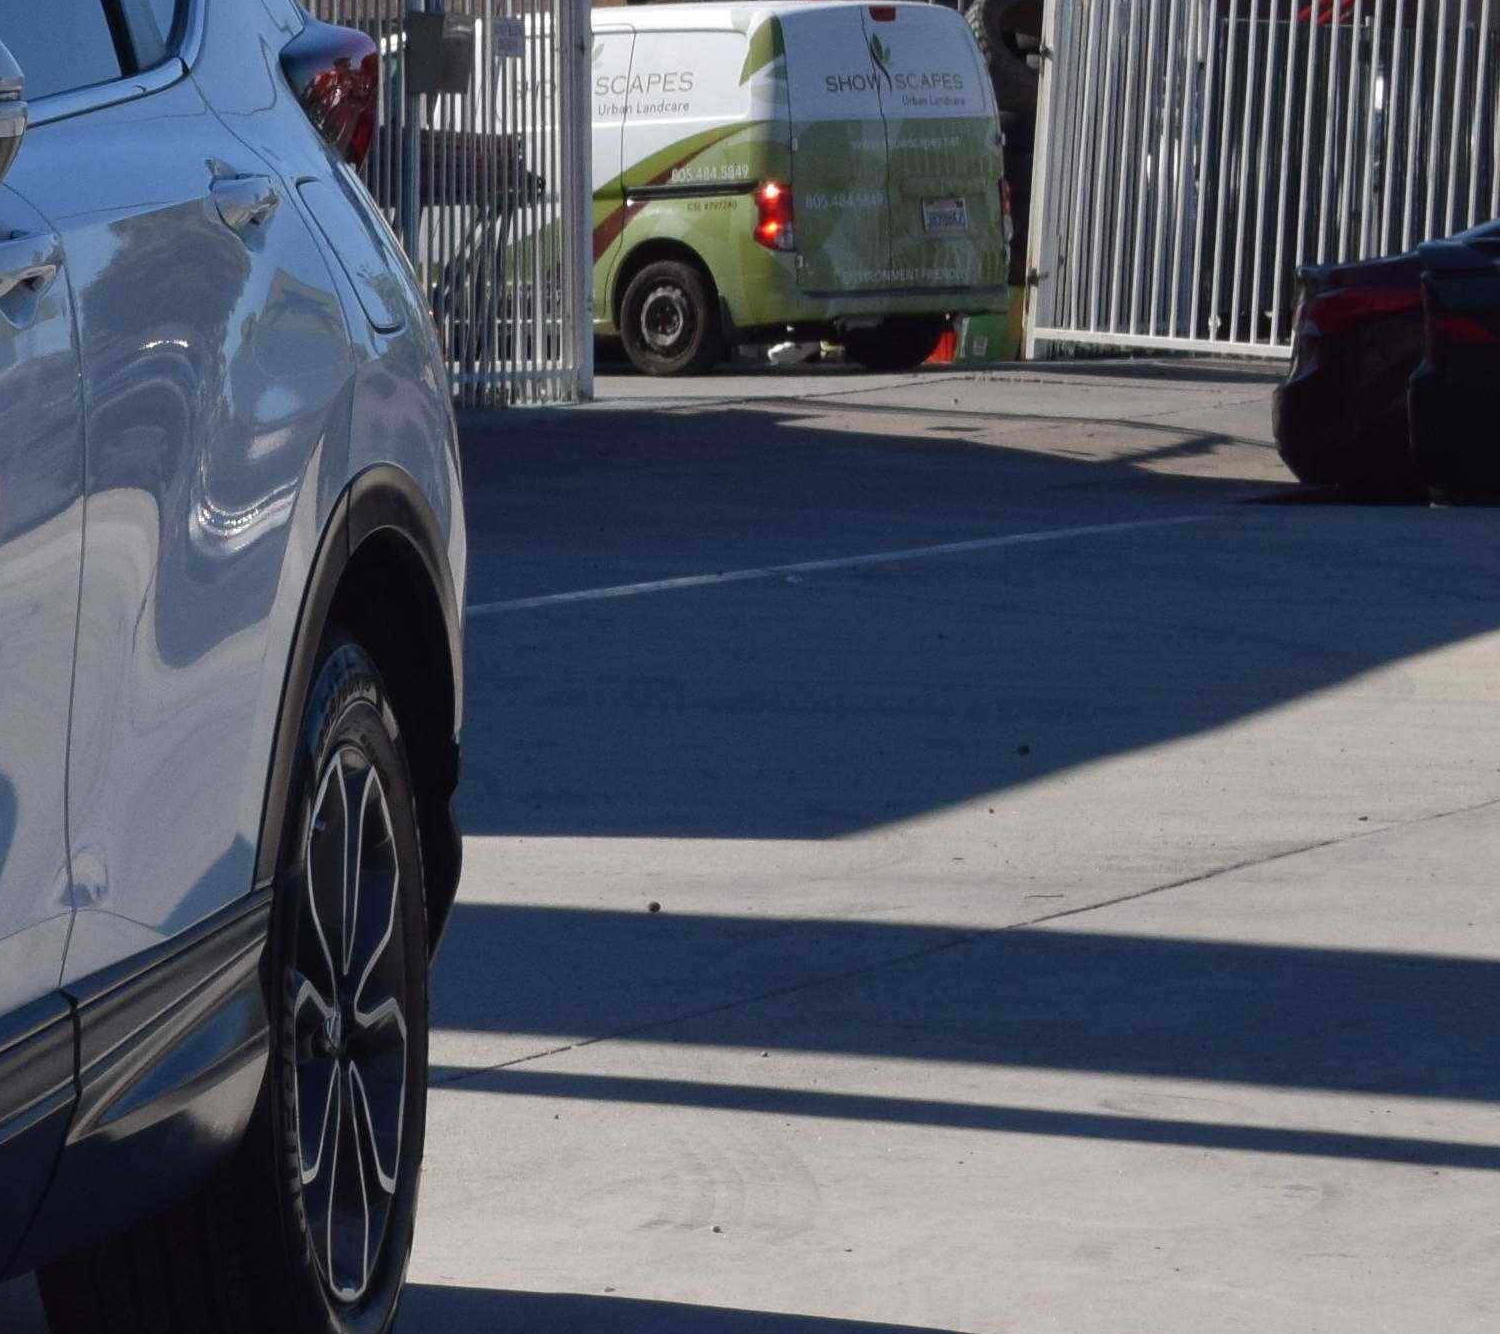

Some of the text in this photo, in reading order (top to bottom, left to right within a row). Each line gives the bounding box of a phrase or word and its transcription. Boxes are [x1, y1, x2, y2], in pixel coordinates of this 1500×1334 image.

[594, 71, 694, 96] SCAPES
[825, 72, 964, 94] SHOW SCAPES
[597, 99, 690, 116] Urban Landcare
